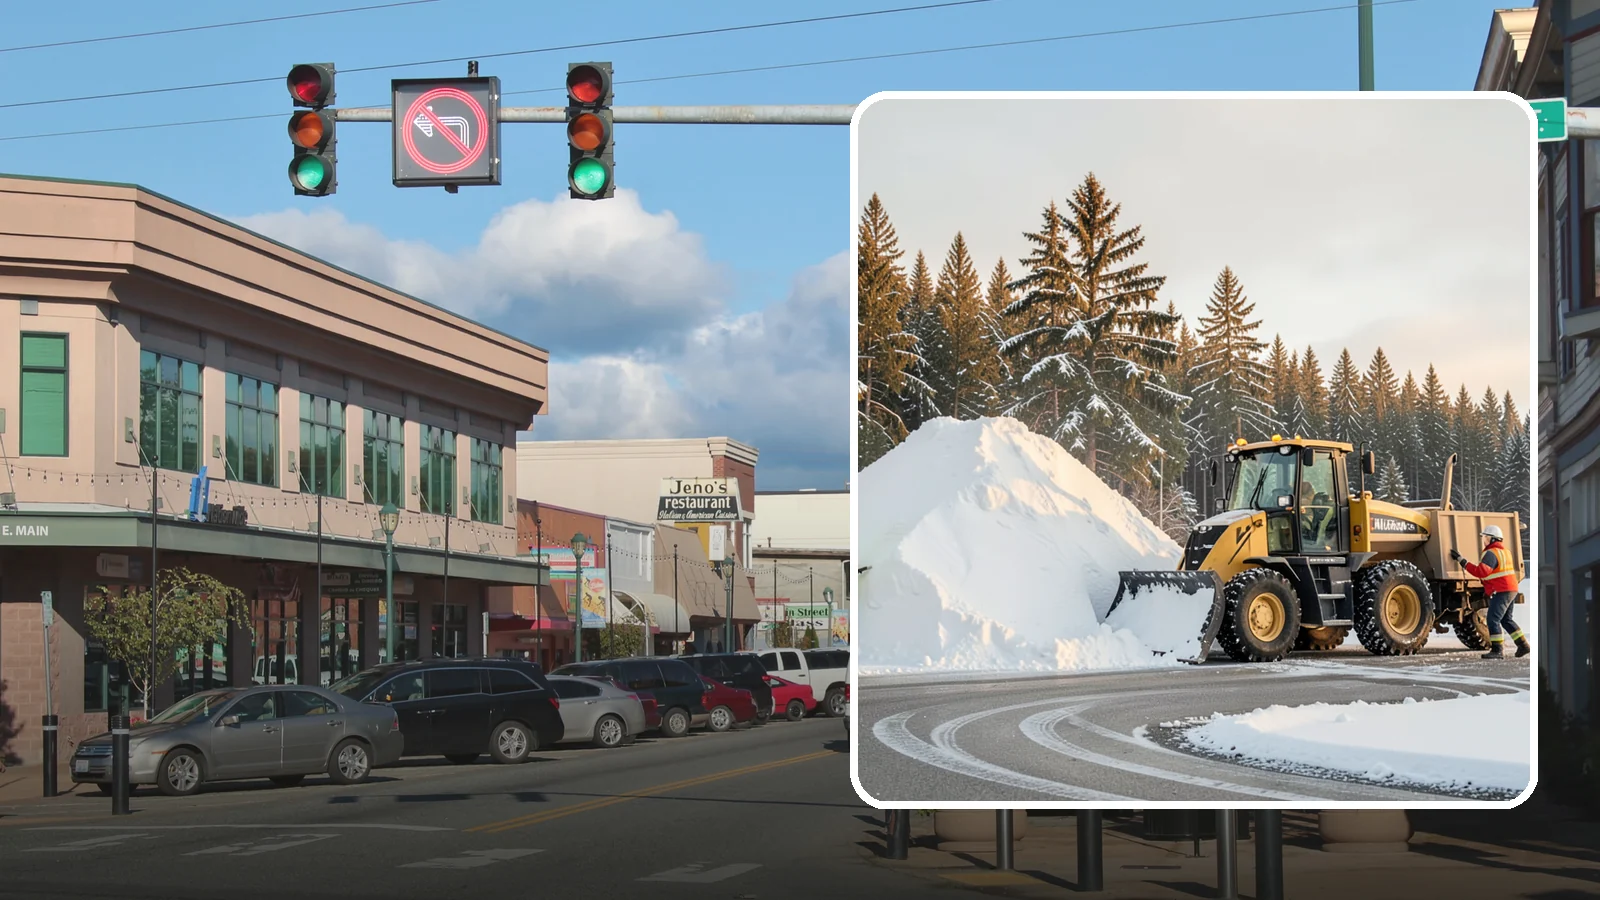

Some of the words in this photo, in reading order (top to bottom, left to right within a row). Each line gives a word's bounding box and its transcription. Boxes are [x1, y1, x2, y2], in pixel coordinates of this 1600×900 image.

[670, 480, 727, 494] Jeno's
[665, 497, 731, 509] restaurant
[658, 510, 681, 519] Italian
[686, 510, 714, 519] American
[715, 509, 738, 519] Cuisine
[2, 525, 13, 536] E.
[15, 525, 49, 536] MAIN
[797, 607, 829, 617] Street
[790, 619, 824, 627] lass
